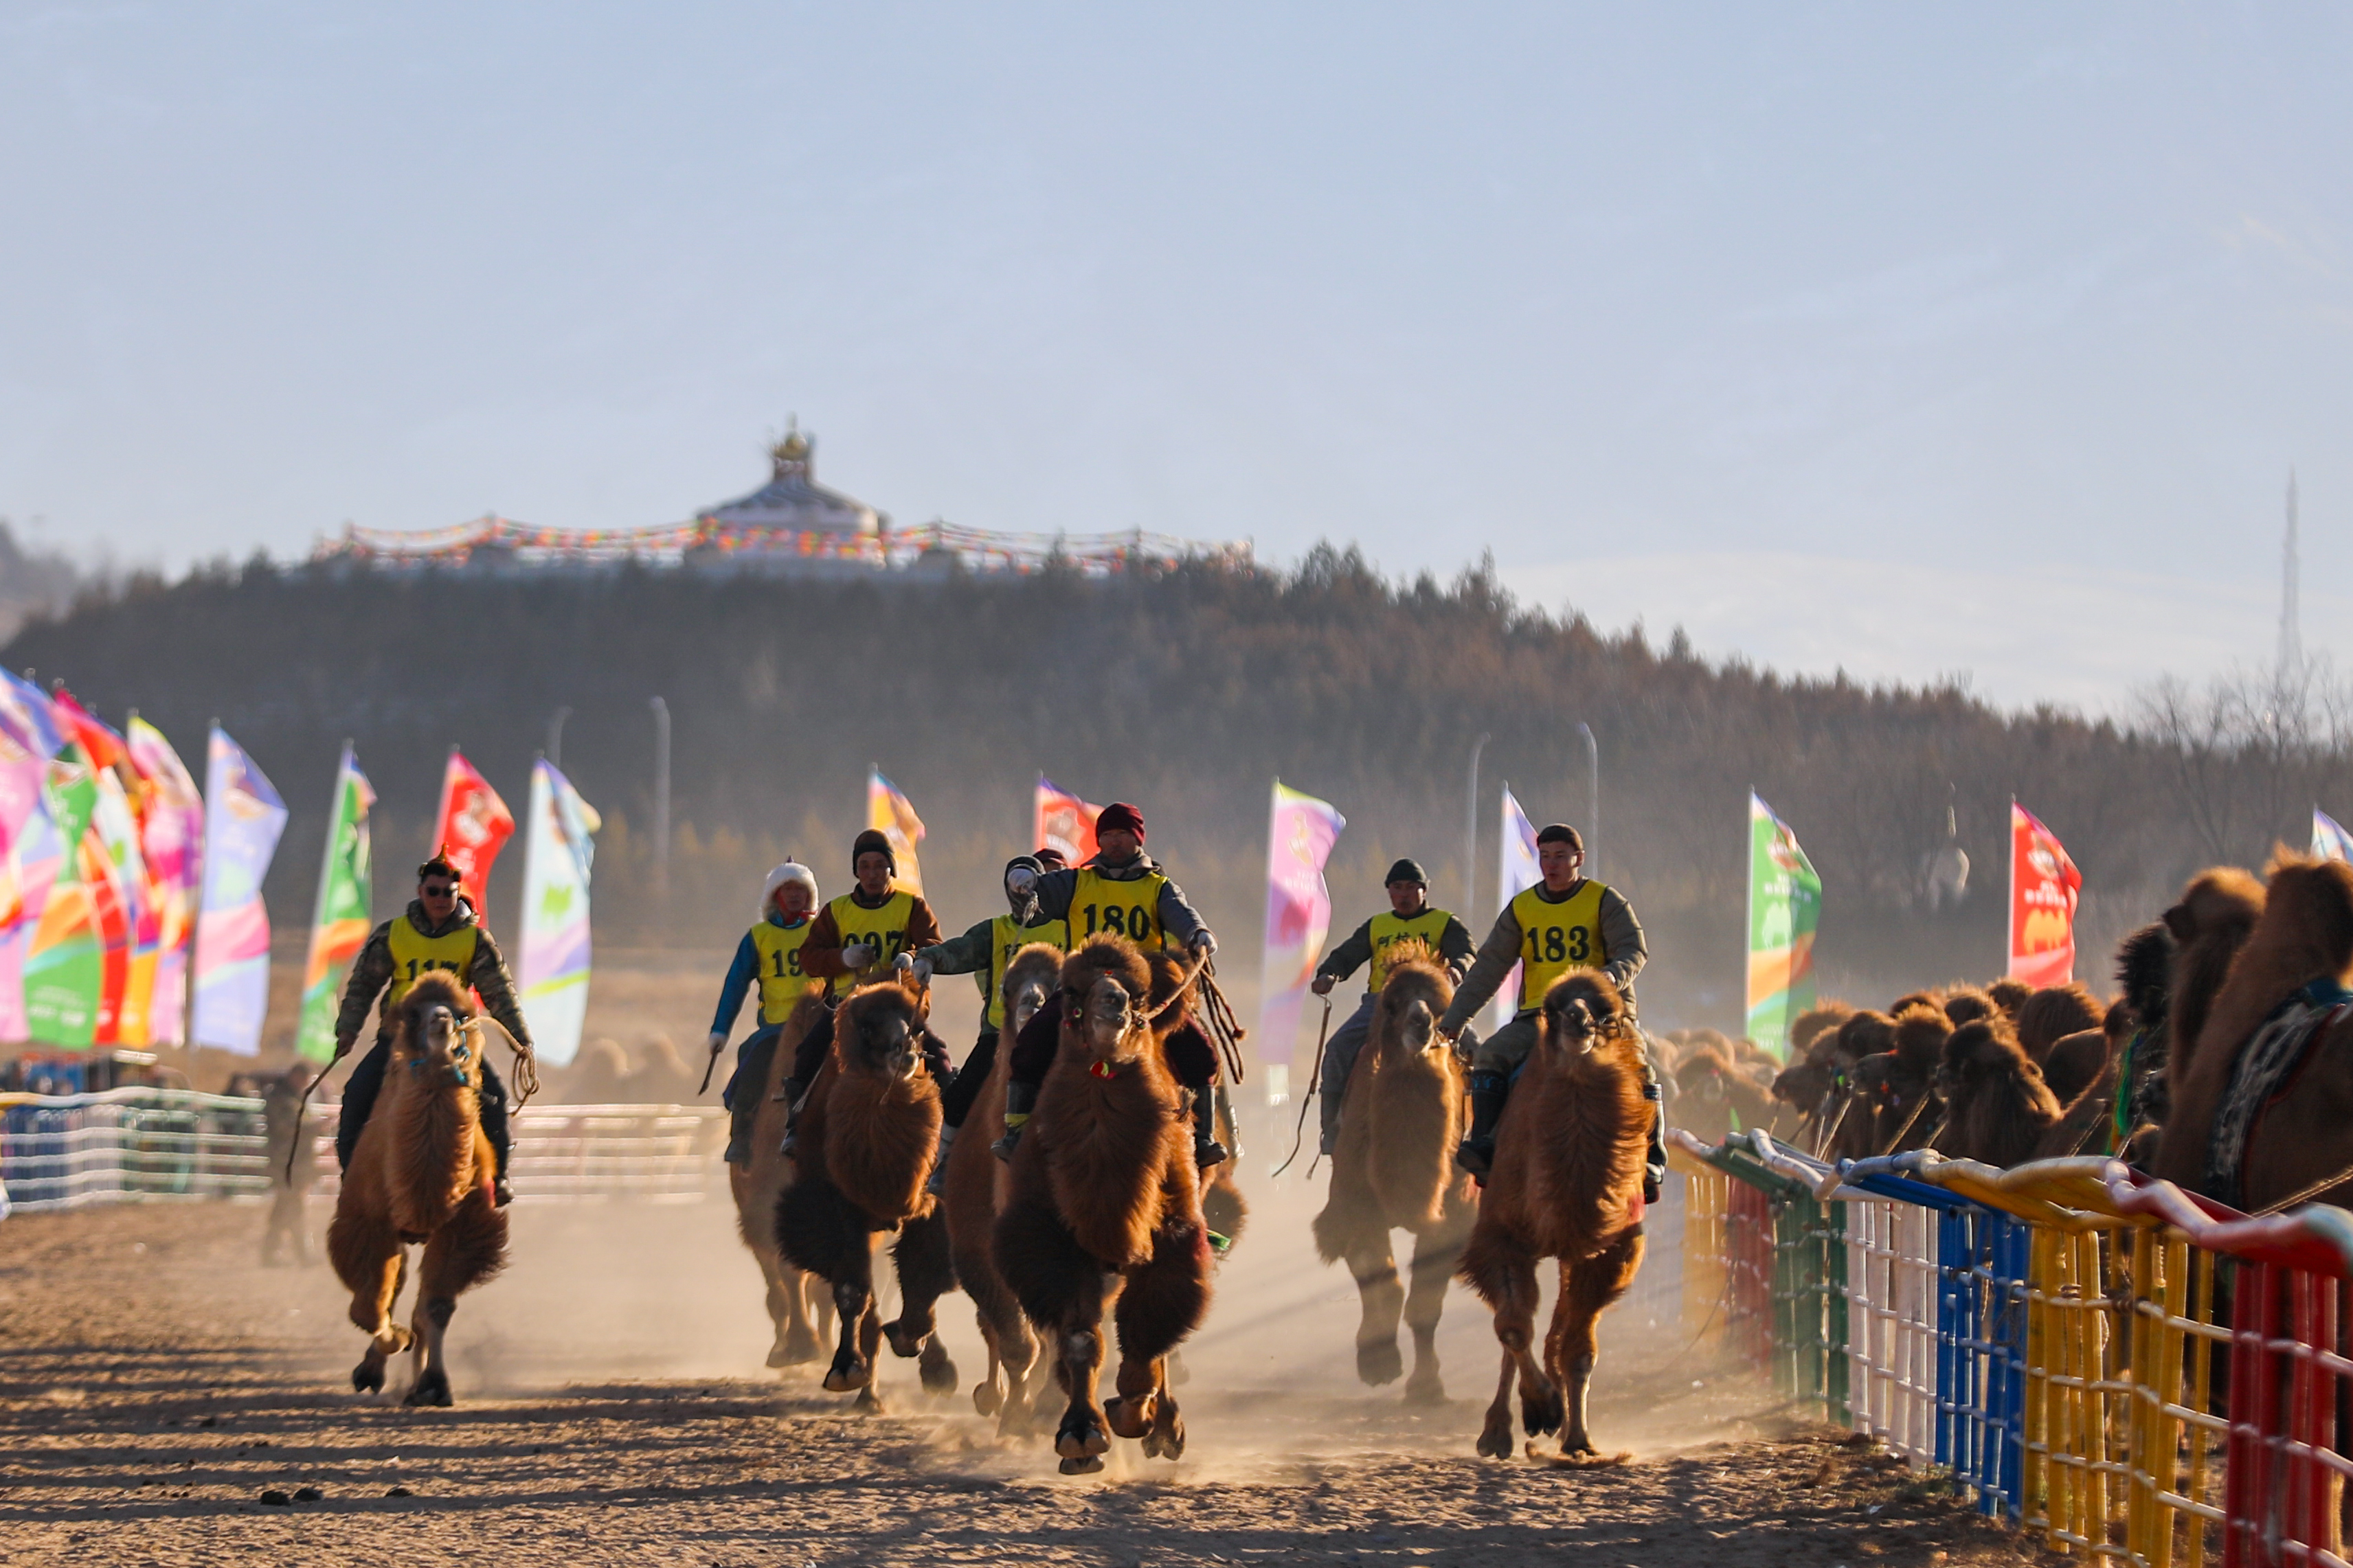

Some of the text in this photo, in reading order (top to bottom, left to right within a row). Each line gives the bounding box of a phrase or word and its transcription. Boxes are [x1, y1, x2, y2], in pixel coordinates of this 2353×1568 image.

[1083, 903, 1150, 942] 180
[772, 948, 804, 977] 19
[1527, 925, 1590, 963] 183
